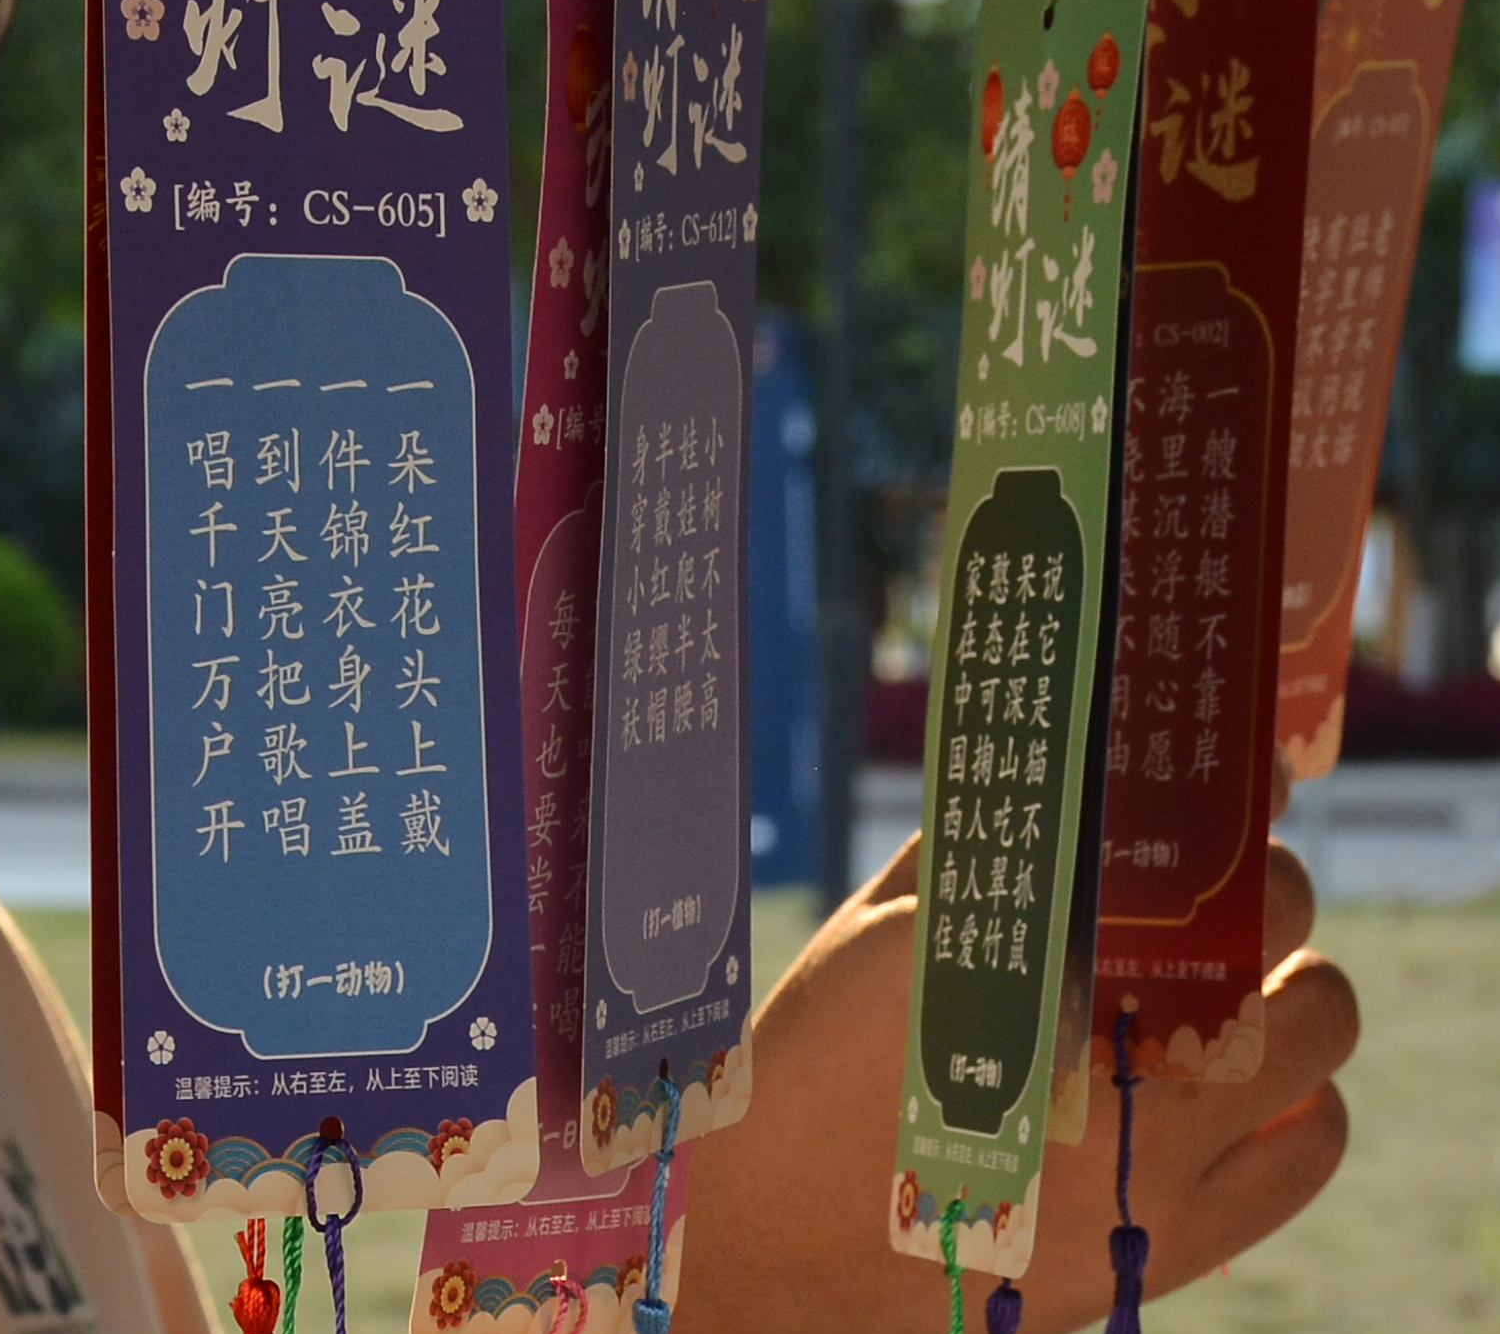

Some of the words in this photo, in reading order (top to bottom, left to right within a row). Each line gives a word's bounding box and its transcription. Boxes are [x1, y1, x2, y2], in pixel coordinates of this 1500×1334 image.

[643, 24, 748, 176] 灯谜
[989, 224, 1098, 367] 灯谜
[185, 377, 246, 864] 一唱千门万户开
[252, 378, 313, 858] 一到天亮把歌唱
[319, 379, 382, 857] 一件锦衣身上盖
[386, 380, 450, 857] 一朵红花头上戴
[528, 589, 580, 1030] 每天也要尝
[933, 551, 985, 962] 家在中国西南住
[982, 553, 1036, 969] 呆在深山吃翠竹
[1007, 552, 1064, 976] 说它是猫不抓鼠
[263, 961, 405, 999] (打一动物)
